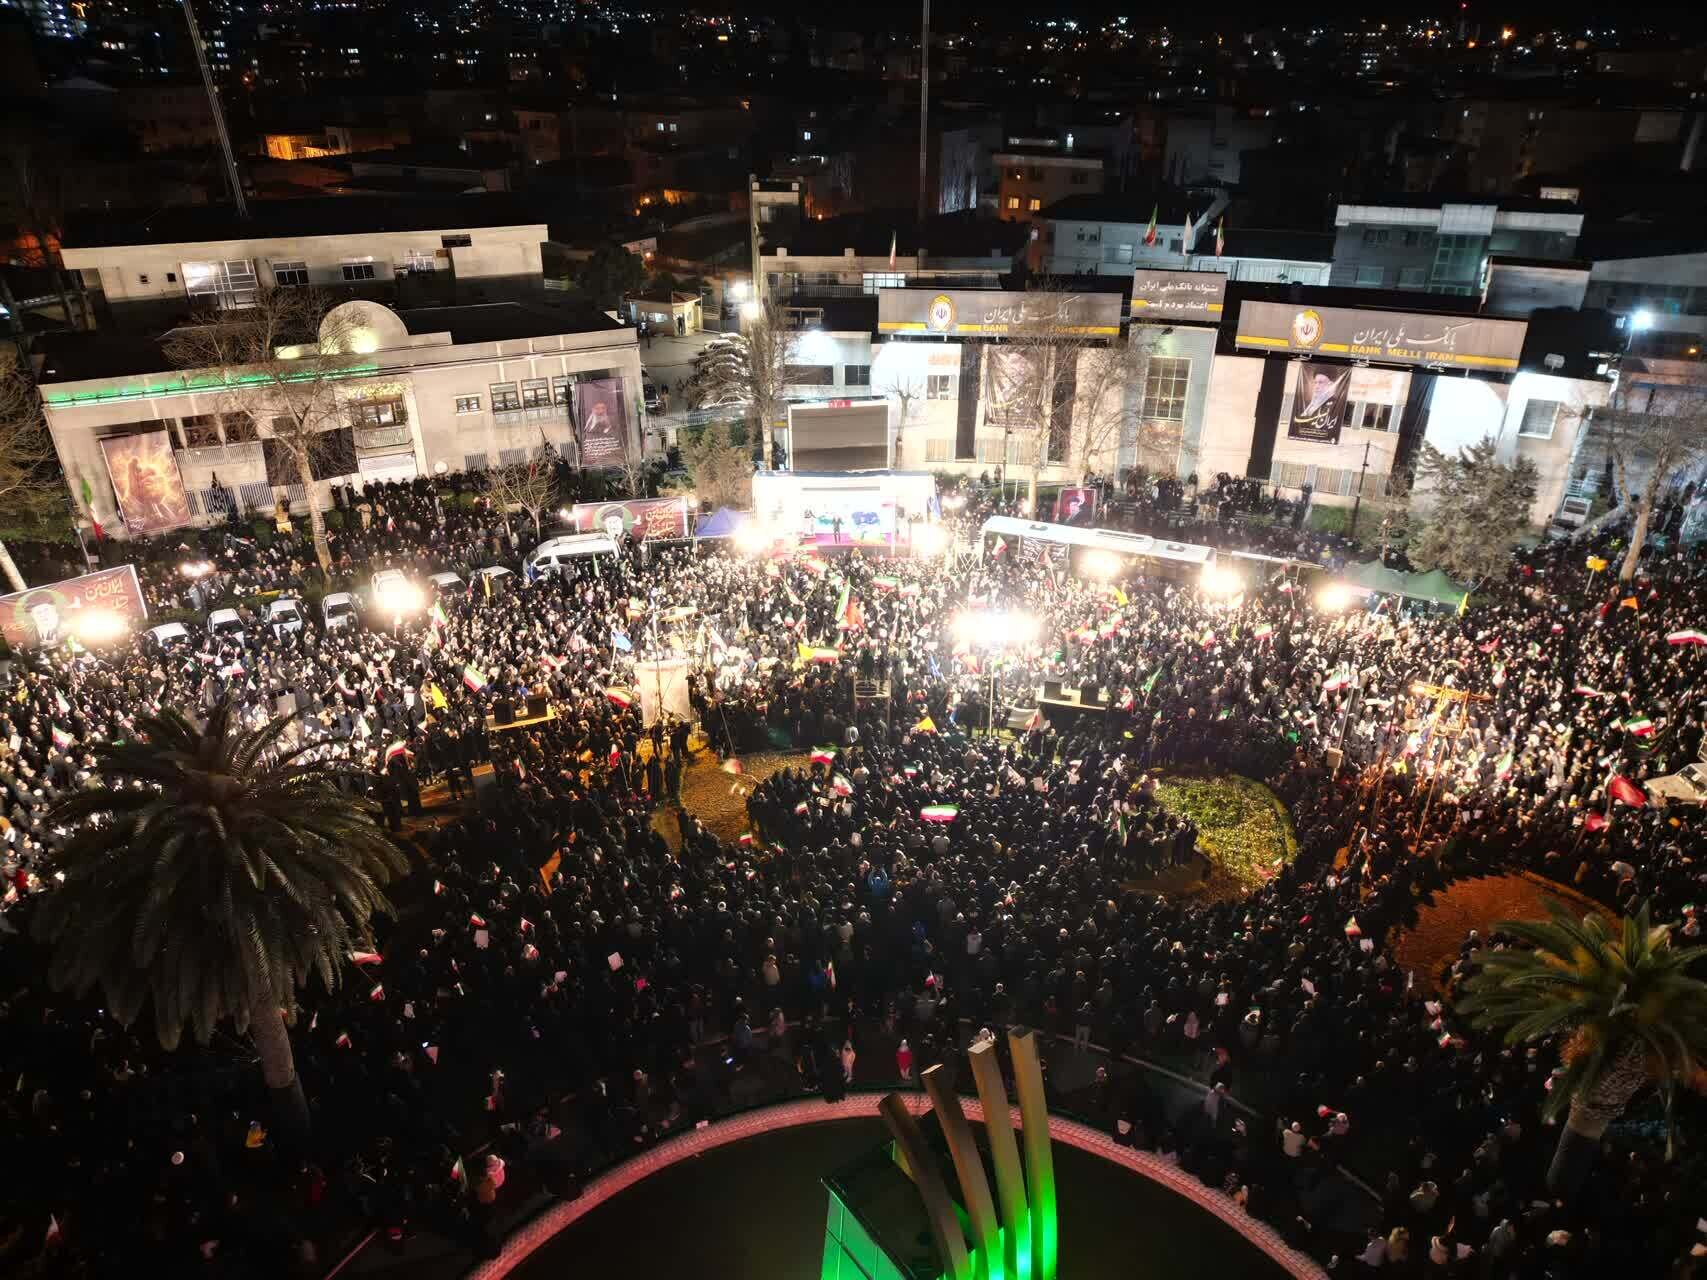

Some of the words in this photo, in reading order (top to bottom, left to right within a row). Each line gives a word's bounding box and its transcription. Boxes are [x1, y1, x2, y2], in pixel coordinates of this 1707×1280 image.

[1139, 281, 1159, 292] ایران
[1160, 281, 1175, 293] ملی
[1175, 281, 1193, 292] بانک
[1163, 301, 1184, 311] مردم
[1185, 301, 1208, 310] اعتماد
[983, 303, 1012, 325] ایران
[1353, 327, 1389, 346] ایران
[1406, 322, 1473, 351] بانک
[1350, 344, 1382, 355] BANK
[1387, 347, 1422, 360] MELLI
[1424, 351, 1455, 362] IRAN
[1315, 415, 1338, 430] ایران
